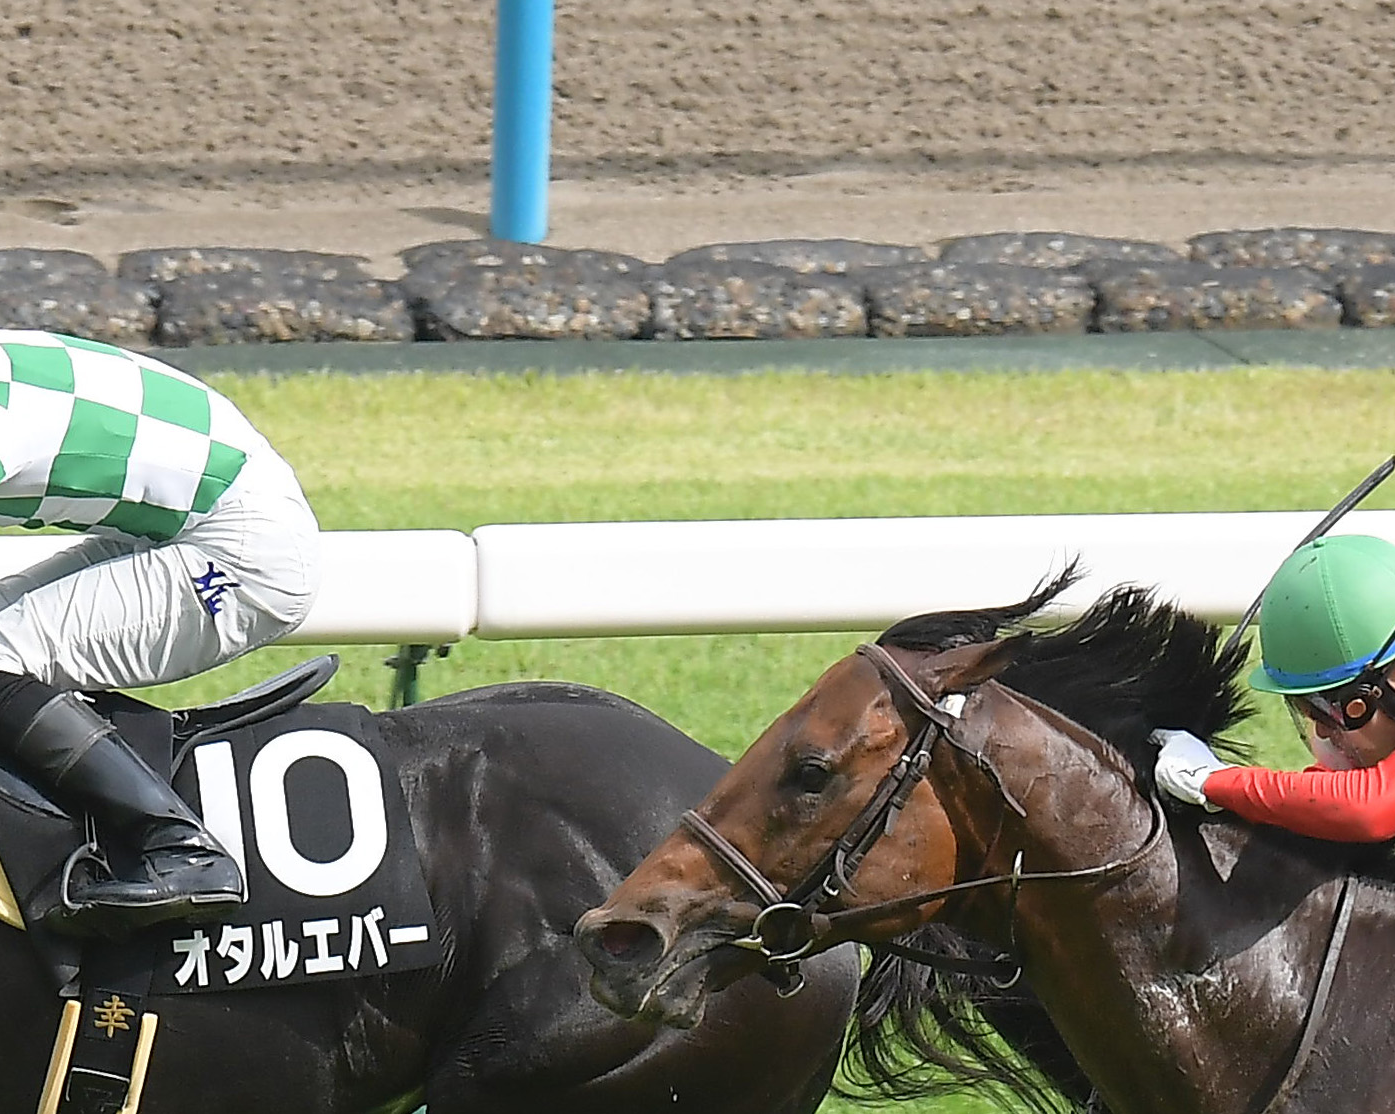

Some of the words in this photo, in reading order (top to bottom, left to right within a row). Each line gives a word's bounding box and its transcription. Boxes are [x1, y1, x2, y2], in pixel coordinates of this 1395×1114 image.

[194, 729, 387, 903] 10
[173, 906, 429, 987] オタルエバー
[93, 994, 136, 1038] 幸
